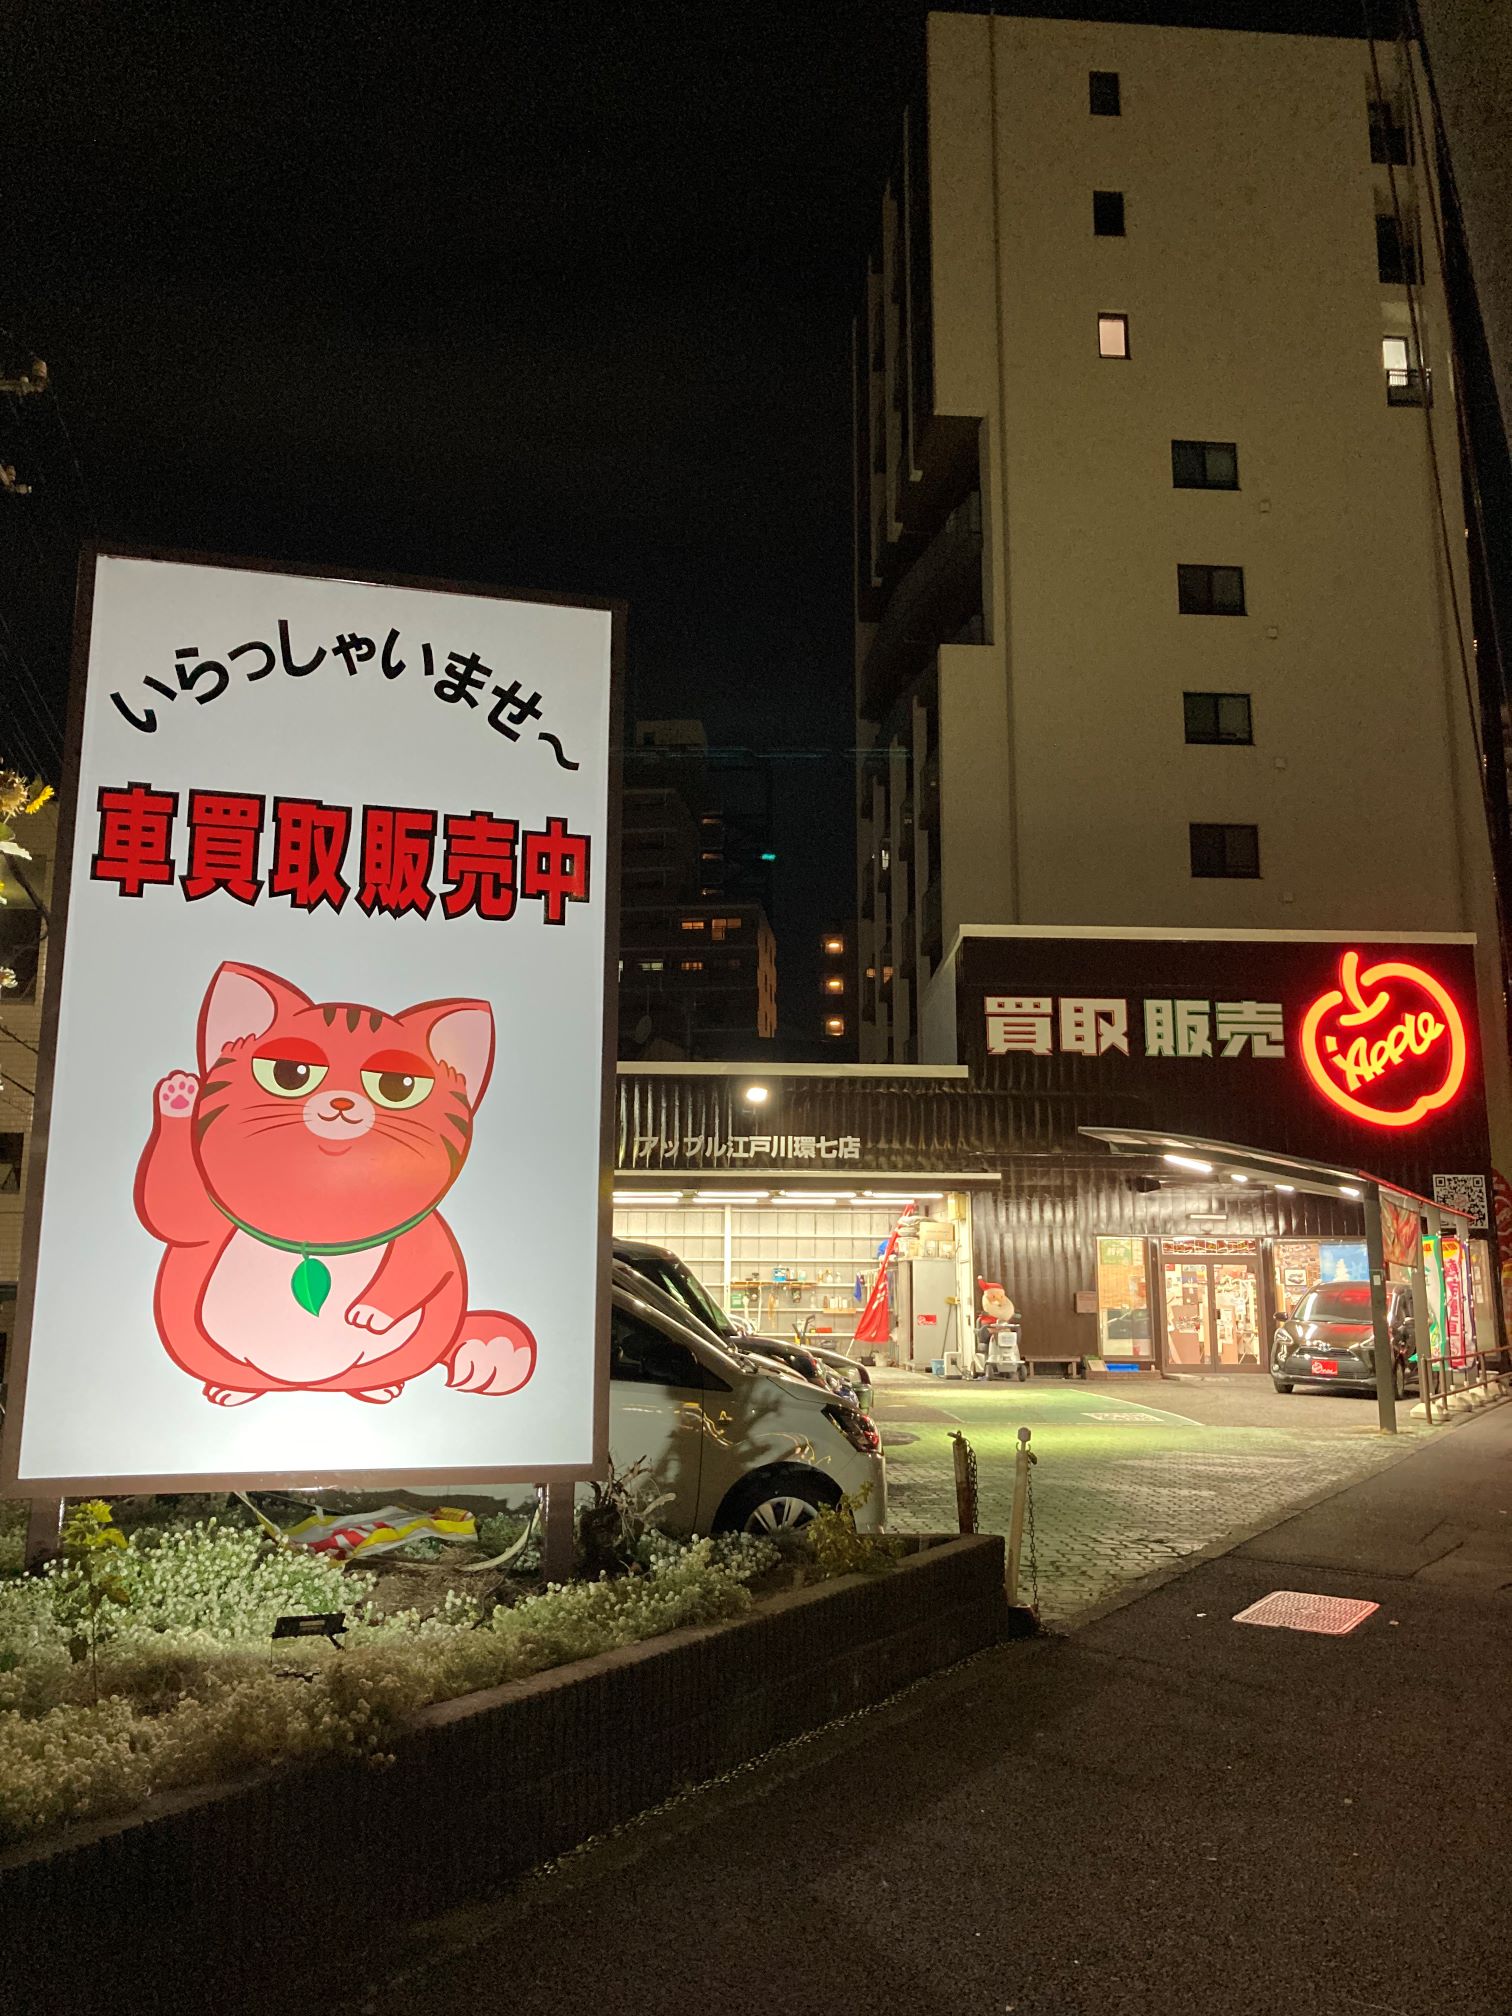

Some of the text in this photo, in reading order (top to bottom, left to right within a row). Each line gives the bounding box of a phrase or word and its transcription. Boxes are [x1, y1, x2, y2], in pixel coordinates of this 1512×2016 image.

[90, 782, 592, 926] 車買取販売中
[1325, 1011, 1446, 1093] Apple
[638, 1134, 861, 1159] アップル江戸川環七店
